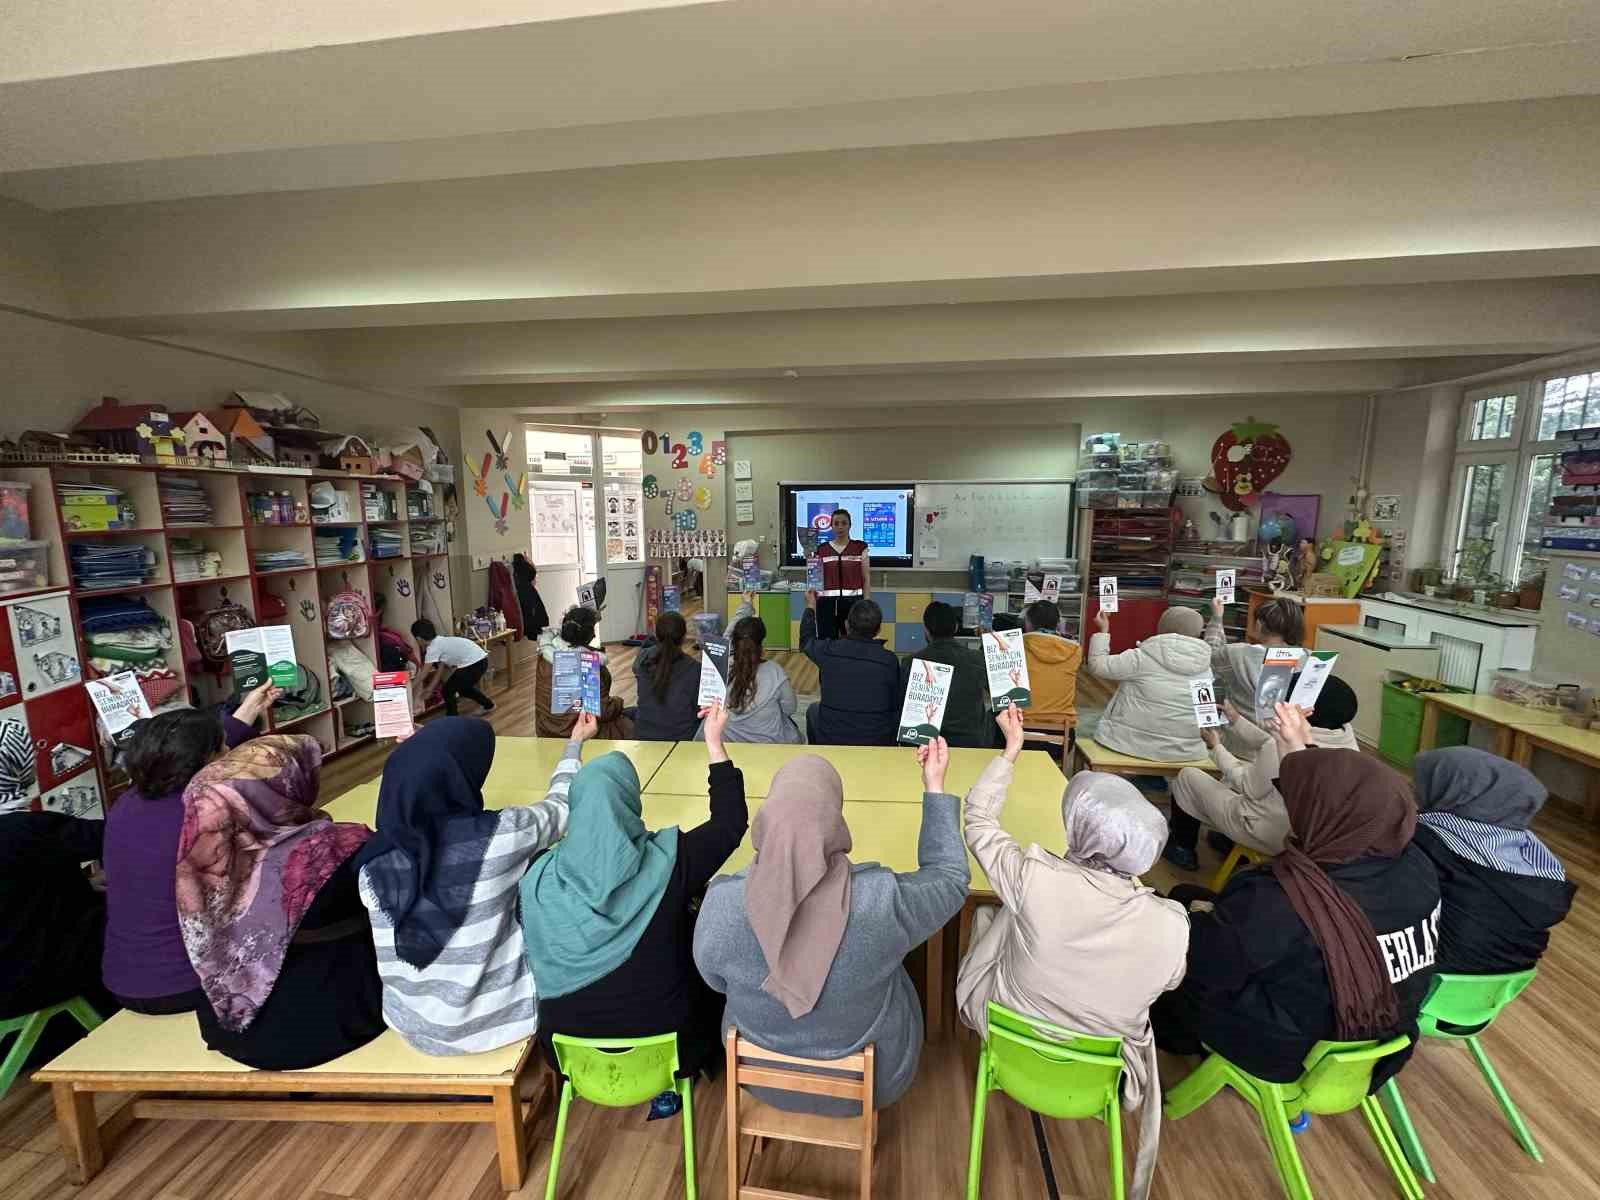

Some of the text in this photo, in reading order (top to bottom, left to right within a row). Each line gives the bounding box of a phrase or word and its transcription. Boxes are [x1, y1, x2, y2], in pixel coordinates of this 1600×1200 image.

[642, 430, 728, 479] 0 1 2 3 4 5
[642, 474, 658, 499] 6
[660, 489, 675, 515] 7
[678, 476, 692, 501] 8
[695, 487, 712, 512] 9
[671, 509, 697, 533] 10
